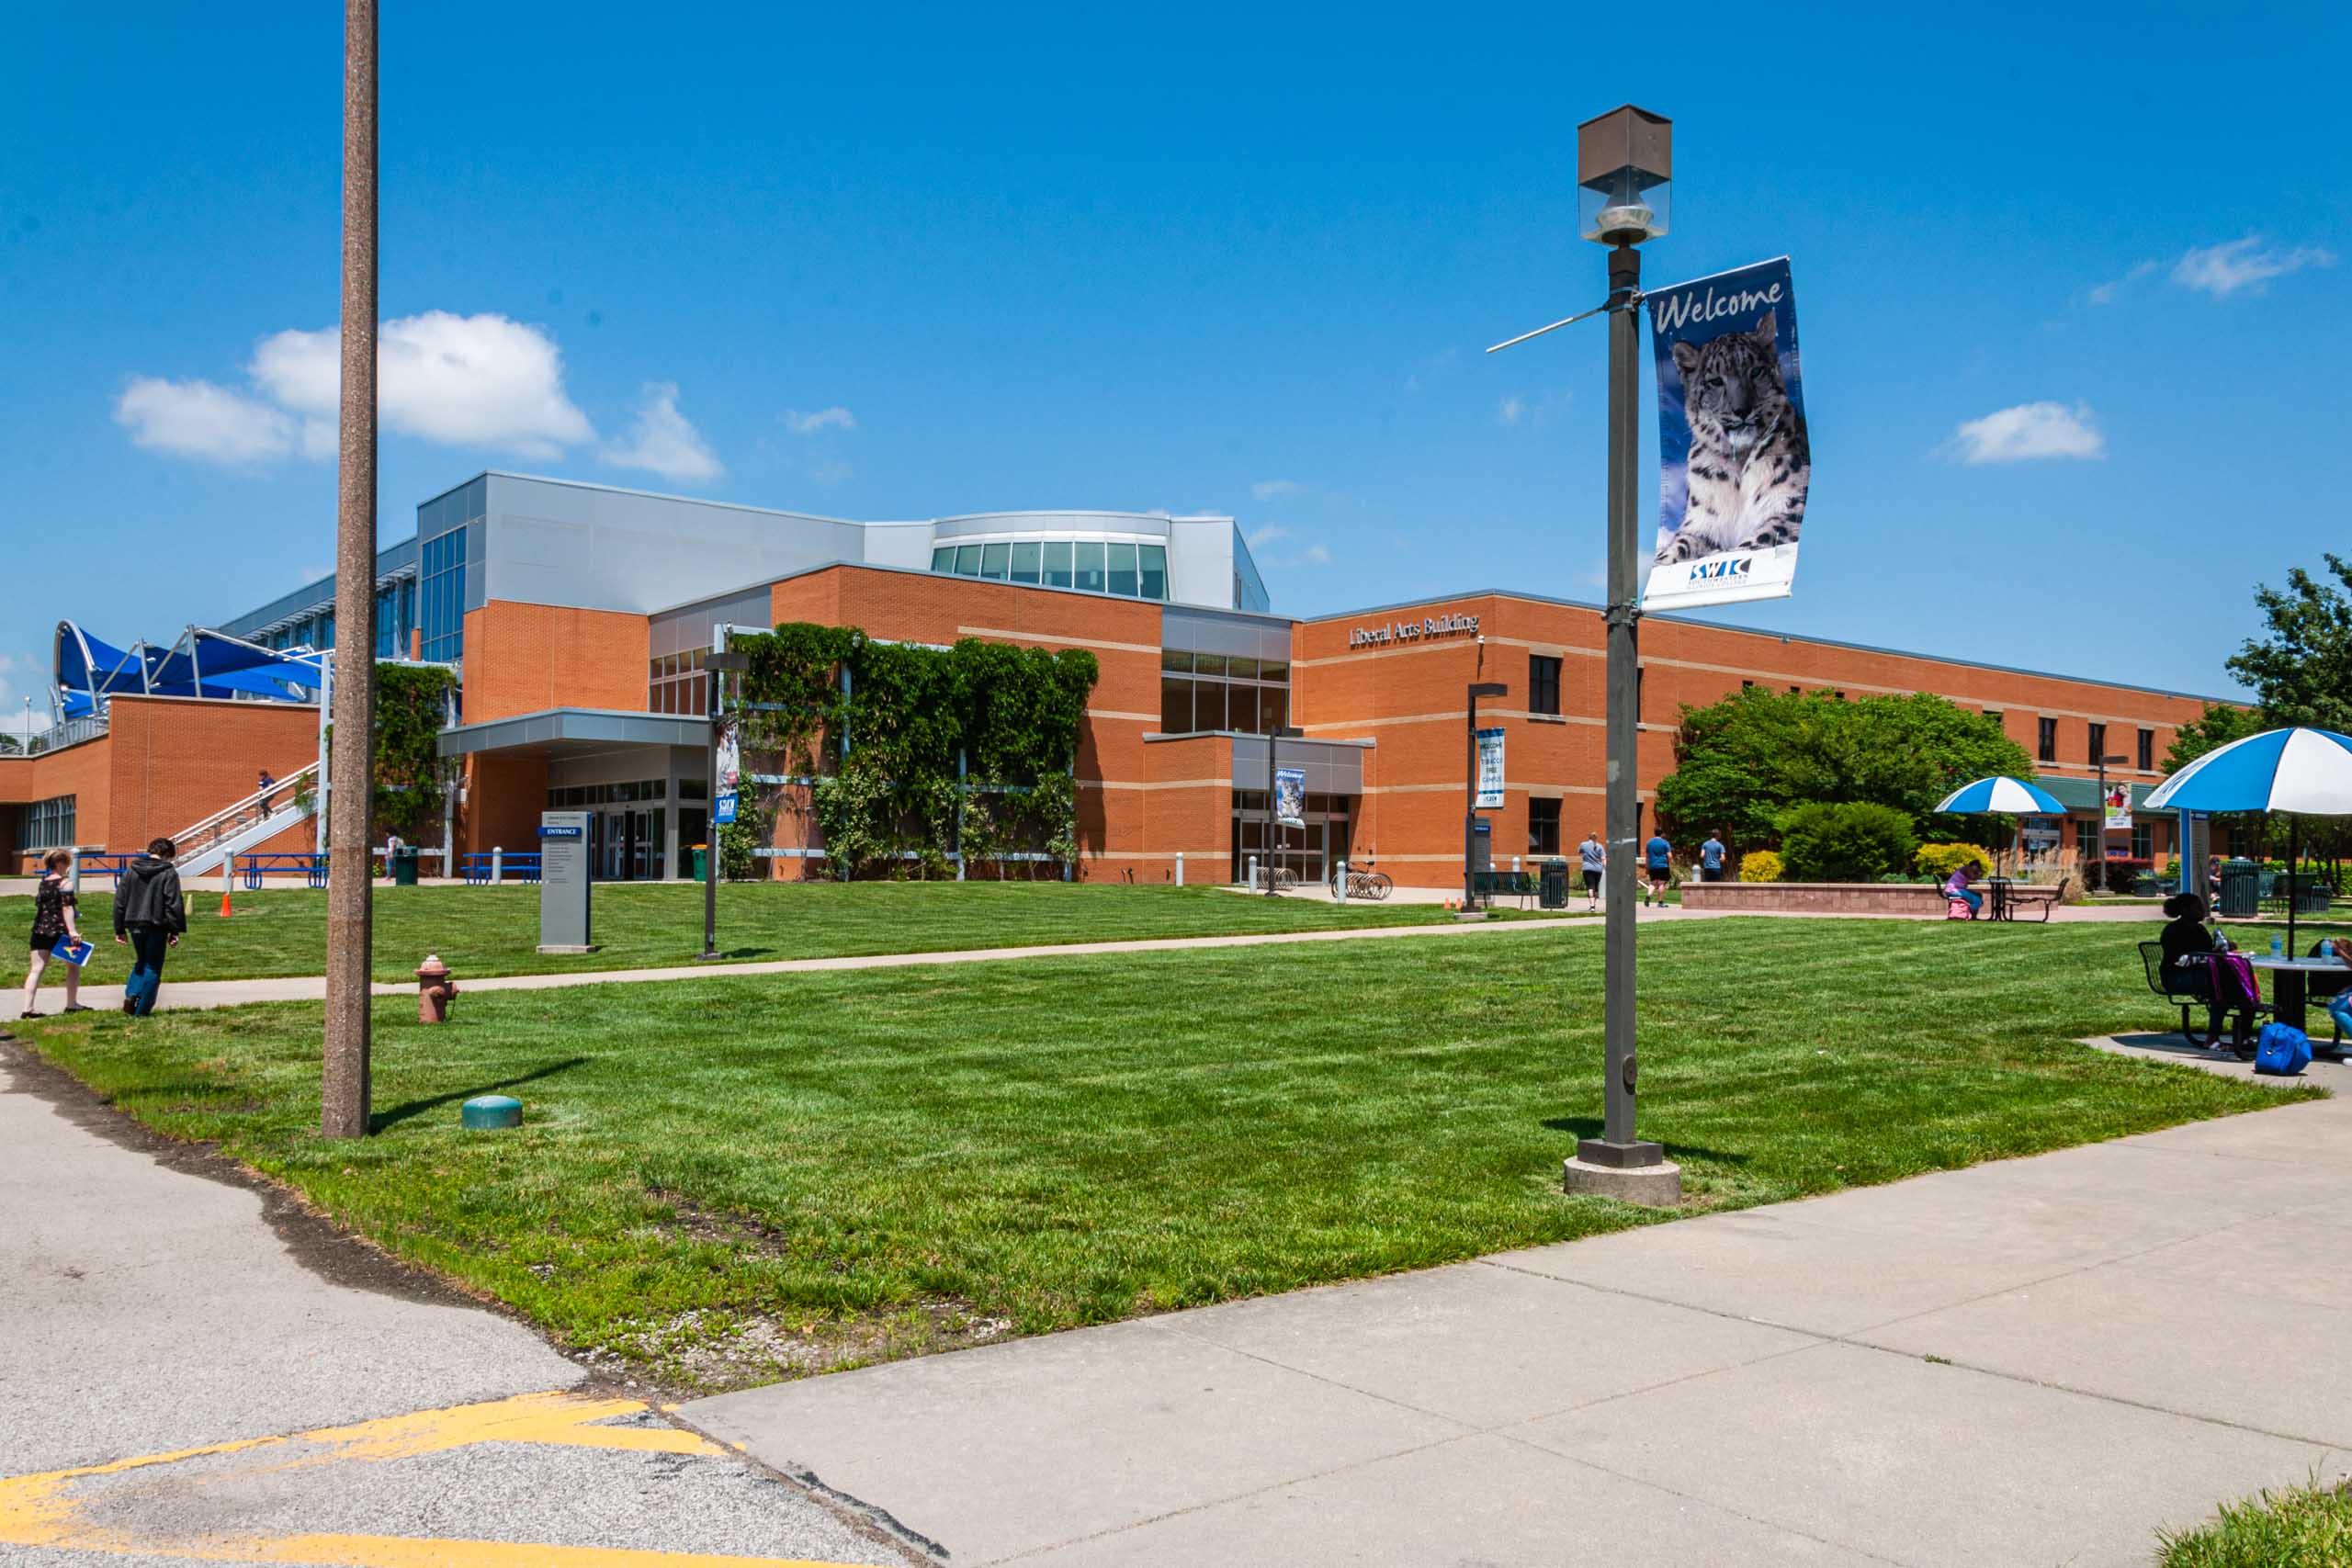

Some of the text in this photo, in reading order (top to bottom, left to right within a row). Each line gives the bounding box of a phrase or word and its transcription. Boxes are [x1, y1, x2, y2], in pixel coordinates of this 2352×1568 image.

[1657, 283, 1784, 333] Welcome
[1690, 558, 1752, 580] SWIC
[1350, 614, 1479, 644] Liberal Arts Building
